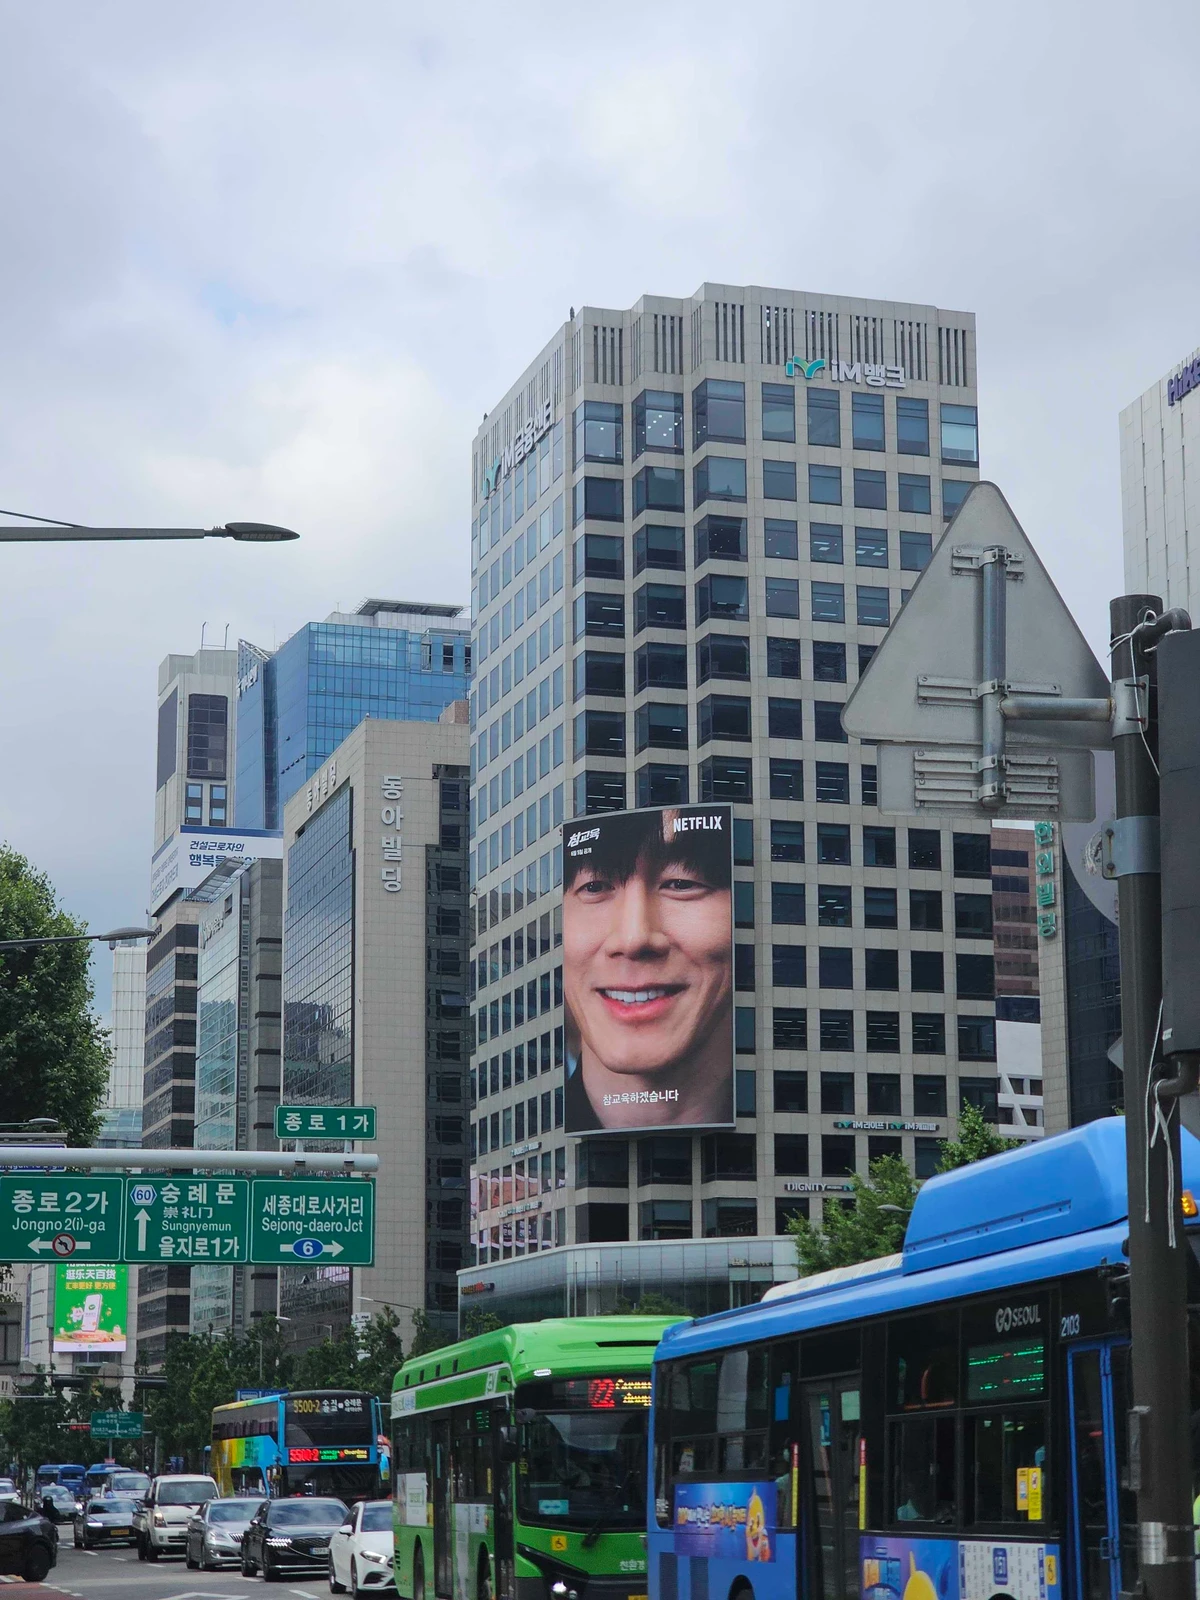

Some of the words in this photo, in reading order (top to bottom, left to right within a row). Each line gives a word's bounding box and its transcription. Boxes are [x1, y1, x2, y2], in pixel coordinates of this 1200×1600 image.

[831, 359, 907, 389] iM뱅크
[673, 815, 722, 833] NETFLIX
[381, 775, 404, 893] 동아빌딩
[567, 827, 600, 848] 참교육
[189, 840, 245, 852] 건설근로자의
[602, 1089, 680, 1106] 참교육하겠습니다
[136, 1189, 151, 1201] 60
[160, 1182, 236, 1205] 숭례문
[787, 1183, 826, 1191] DIGNITY
[11, 1189, 109, 1215] 종로2가
[262, 1194, 364, 1217] 세종대로사거리
[163, 1206, 213, 1219] 崇礼门
[12, 1217, 63, 1234] Jongno
[64, 1216, 106, 1234] 2(i)-ga
[161, 1220, 232, 1234] Sungnyemun
[261, 1217, 343, 1235] Sejong-daero
[344, 1219, 363, 1233] Jct
[158, 1235, 240, 1258] 을지로1가
[302, 1241, 314, 1256] 6
[66, 1269, 117, 1280] 逛乐天百货
[293, 1399, 320, 1413] 5500-2
